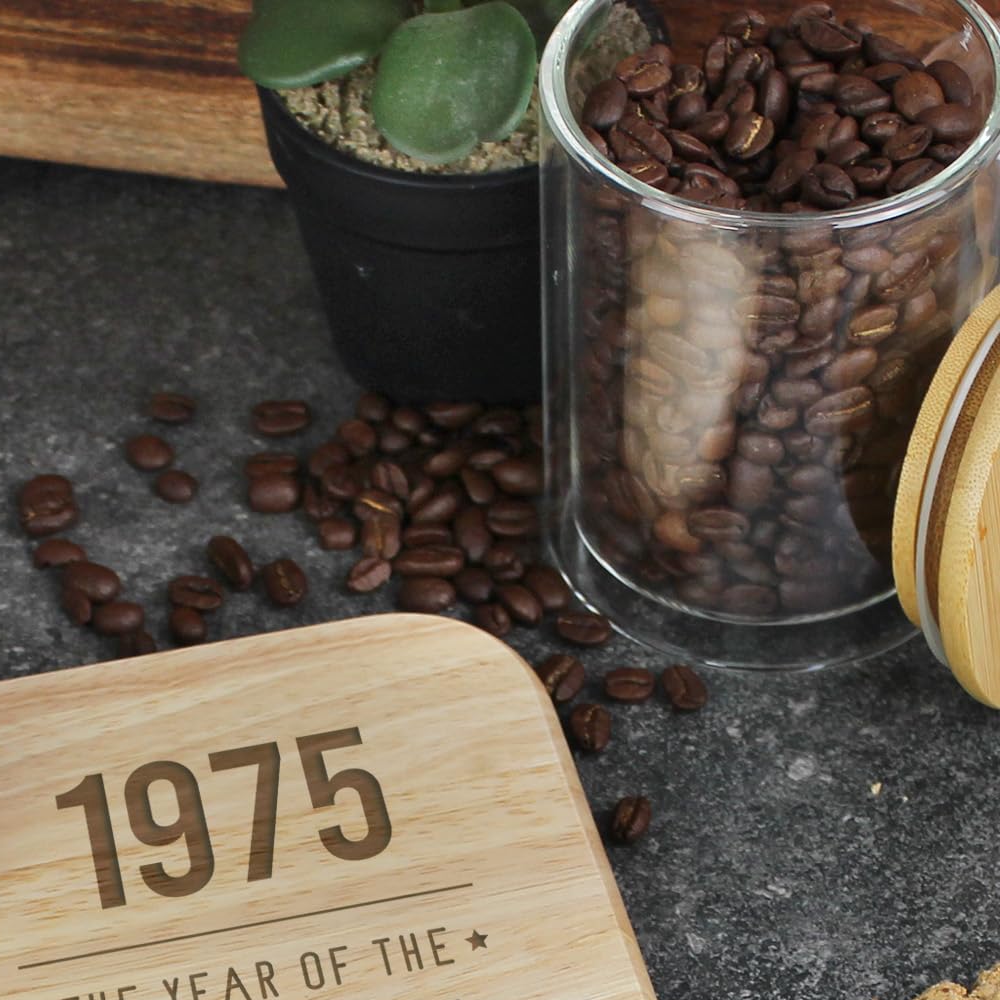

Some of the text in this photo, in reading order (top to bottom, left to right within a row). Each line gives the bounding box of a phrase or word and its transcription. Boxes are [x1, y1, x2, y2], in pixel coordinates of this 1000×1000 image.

[55, 726, 393, 910] 1975
[299, 945, 348, 990] OF
[371, 926, 455, 976] THE
